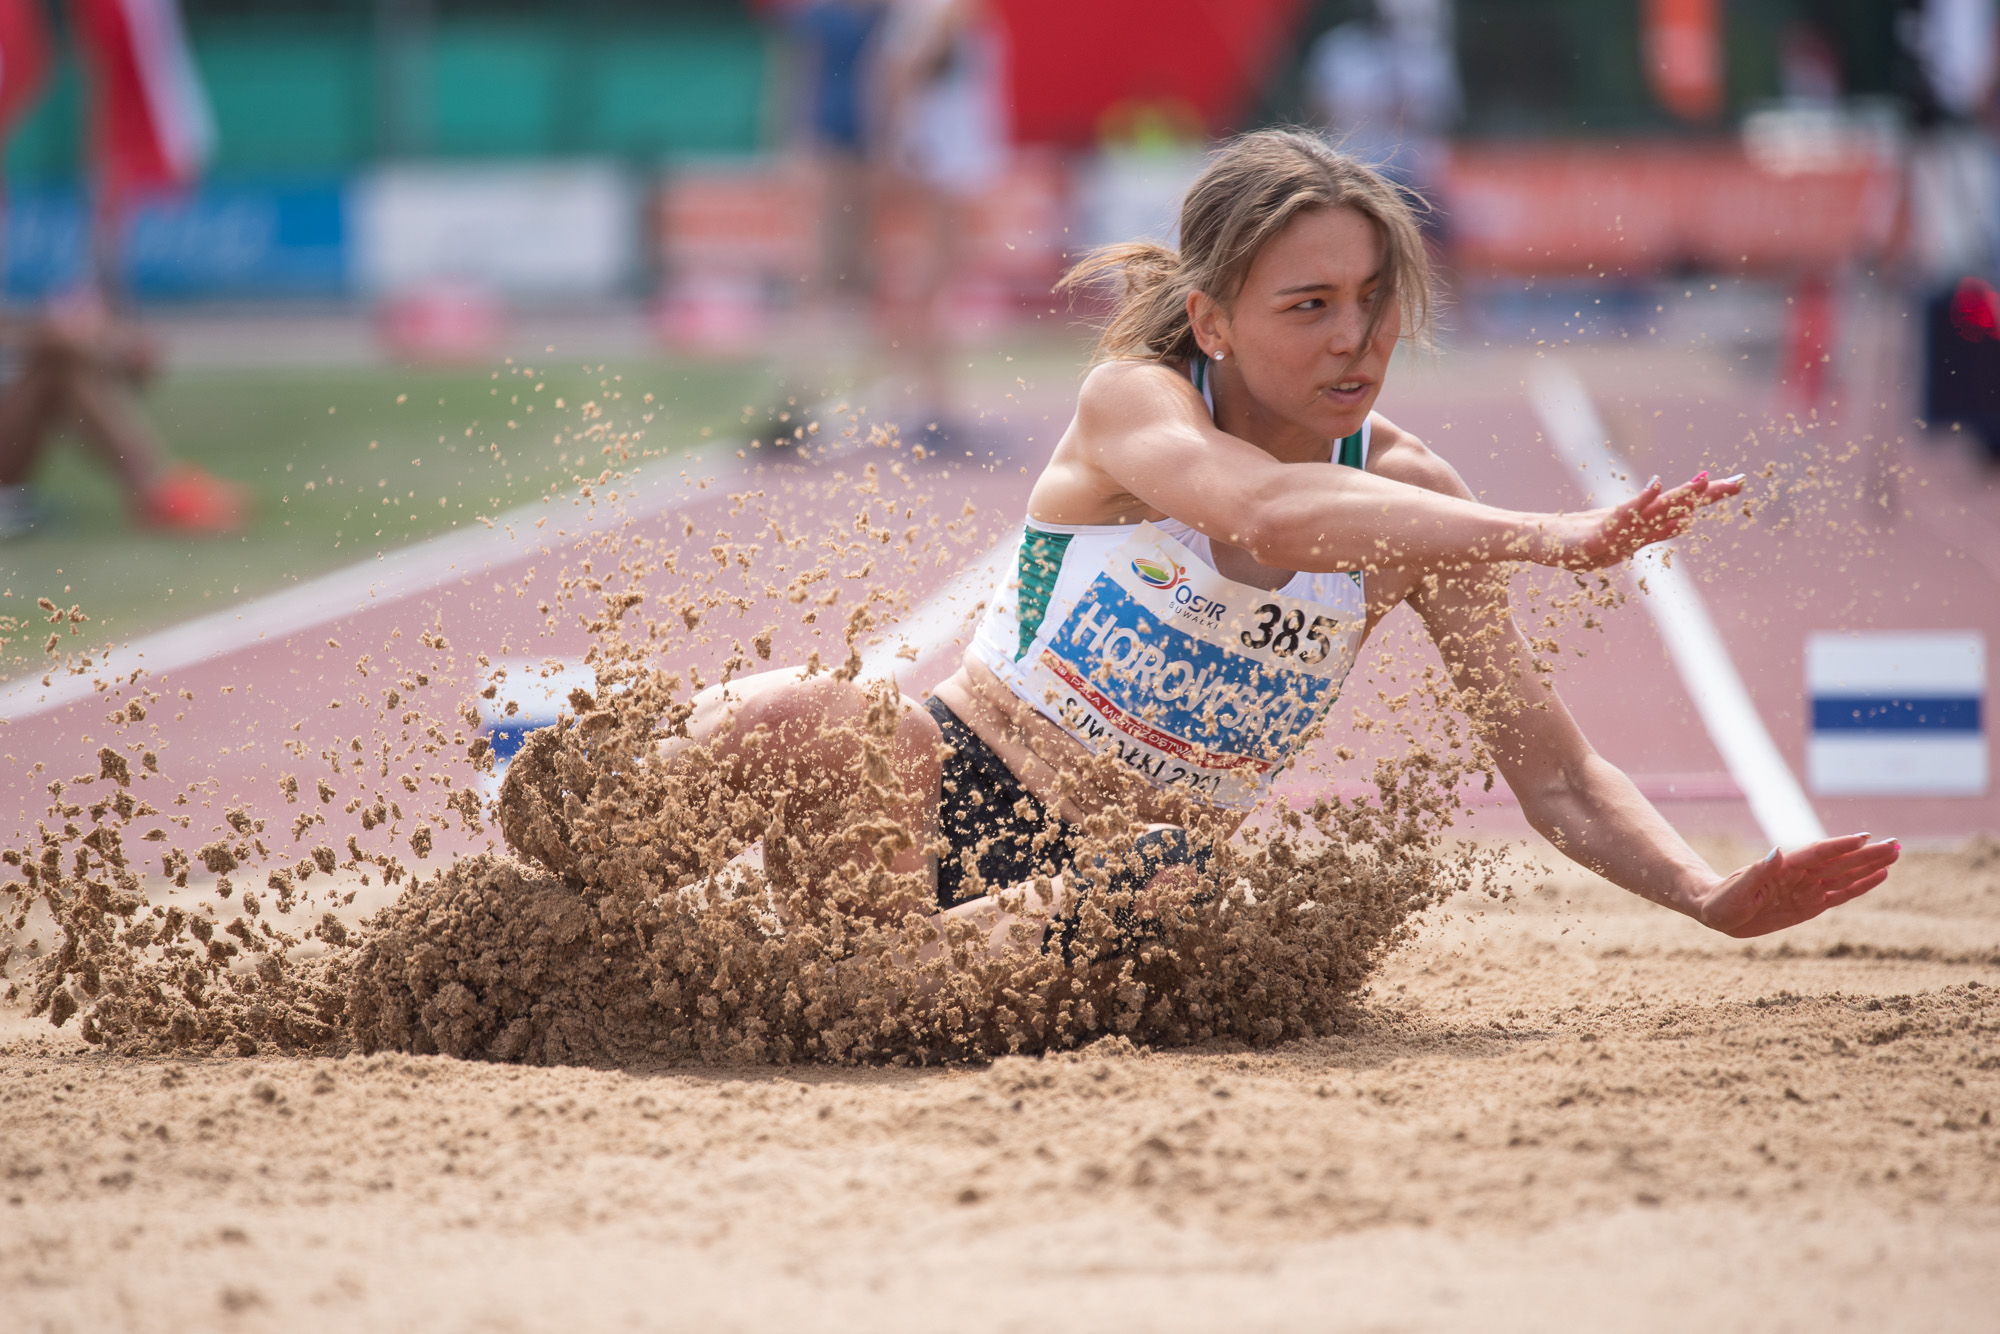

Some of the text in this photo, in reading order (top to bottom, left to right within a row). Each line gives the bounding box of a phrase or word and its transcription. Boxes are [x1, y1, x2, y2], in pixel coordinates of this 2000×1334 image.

[1168, 601, 1219, 630] SUWAŁKI
[1241, 603, 1339, 665] 385
[1071, 601, 1303, 746] HOROWSKA
[1058, 697, 1166, 778] SUWAŁKI
[1070, 676, 1101, 706] PZLA
[1101, 704, 1193, 757] MISTRZOSTWA
